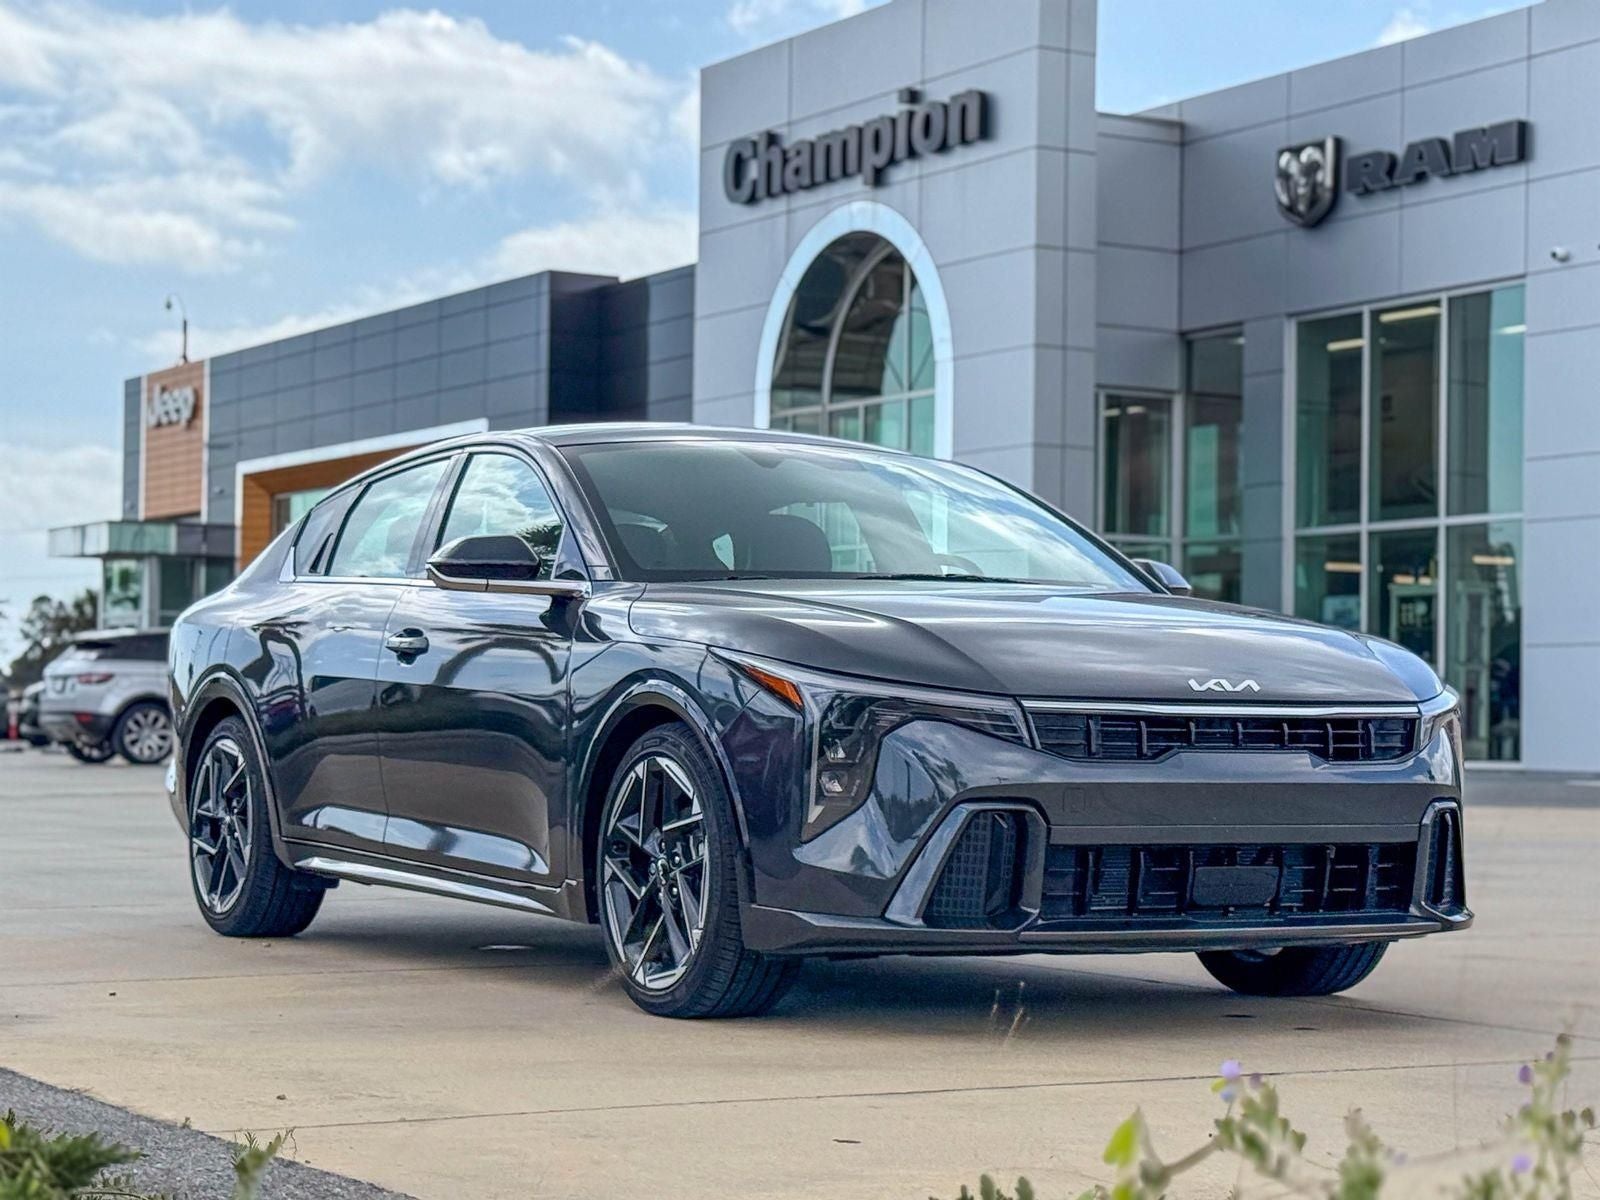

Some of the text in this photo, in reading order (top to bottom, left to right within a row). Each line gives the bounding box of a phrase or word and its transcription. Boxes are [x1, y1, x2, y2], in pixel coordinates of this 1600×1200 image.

[724, 87, 994, 206] Champion
[1347, 119, 1531, 196] RAM
[147, 383, 196, 427] Jeep
[1187, 678, 1261, 693] KIA
